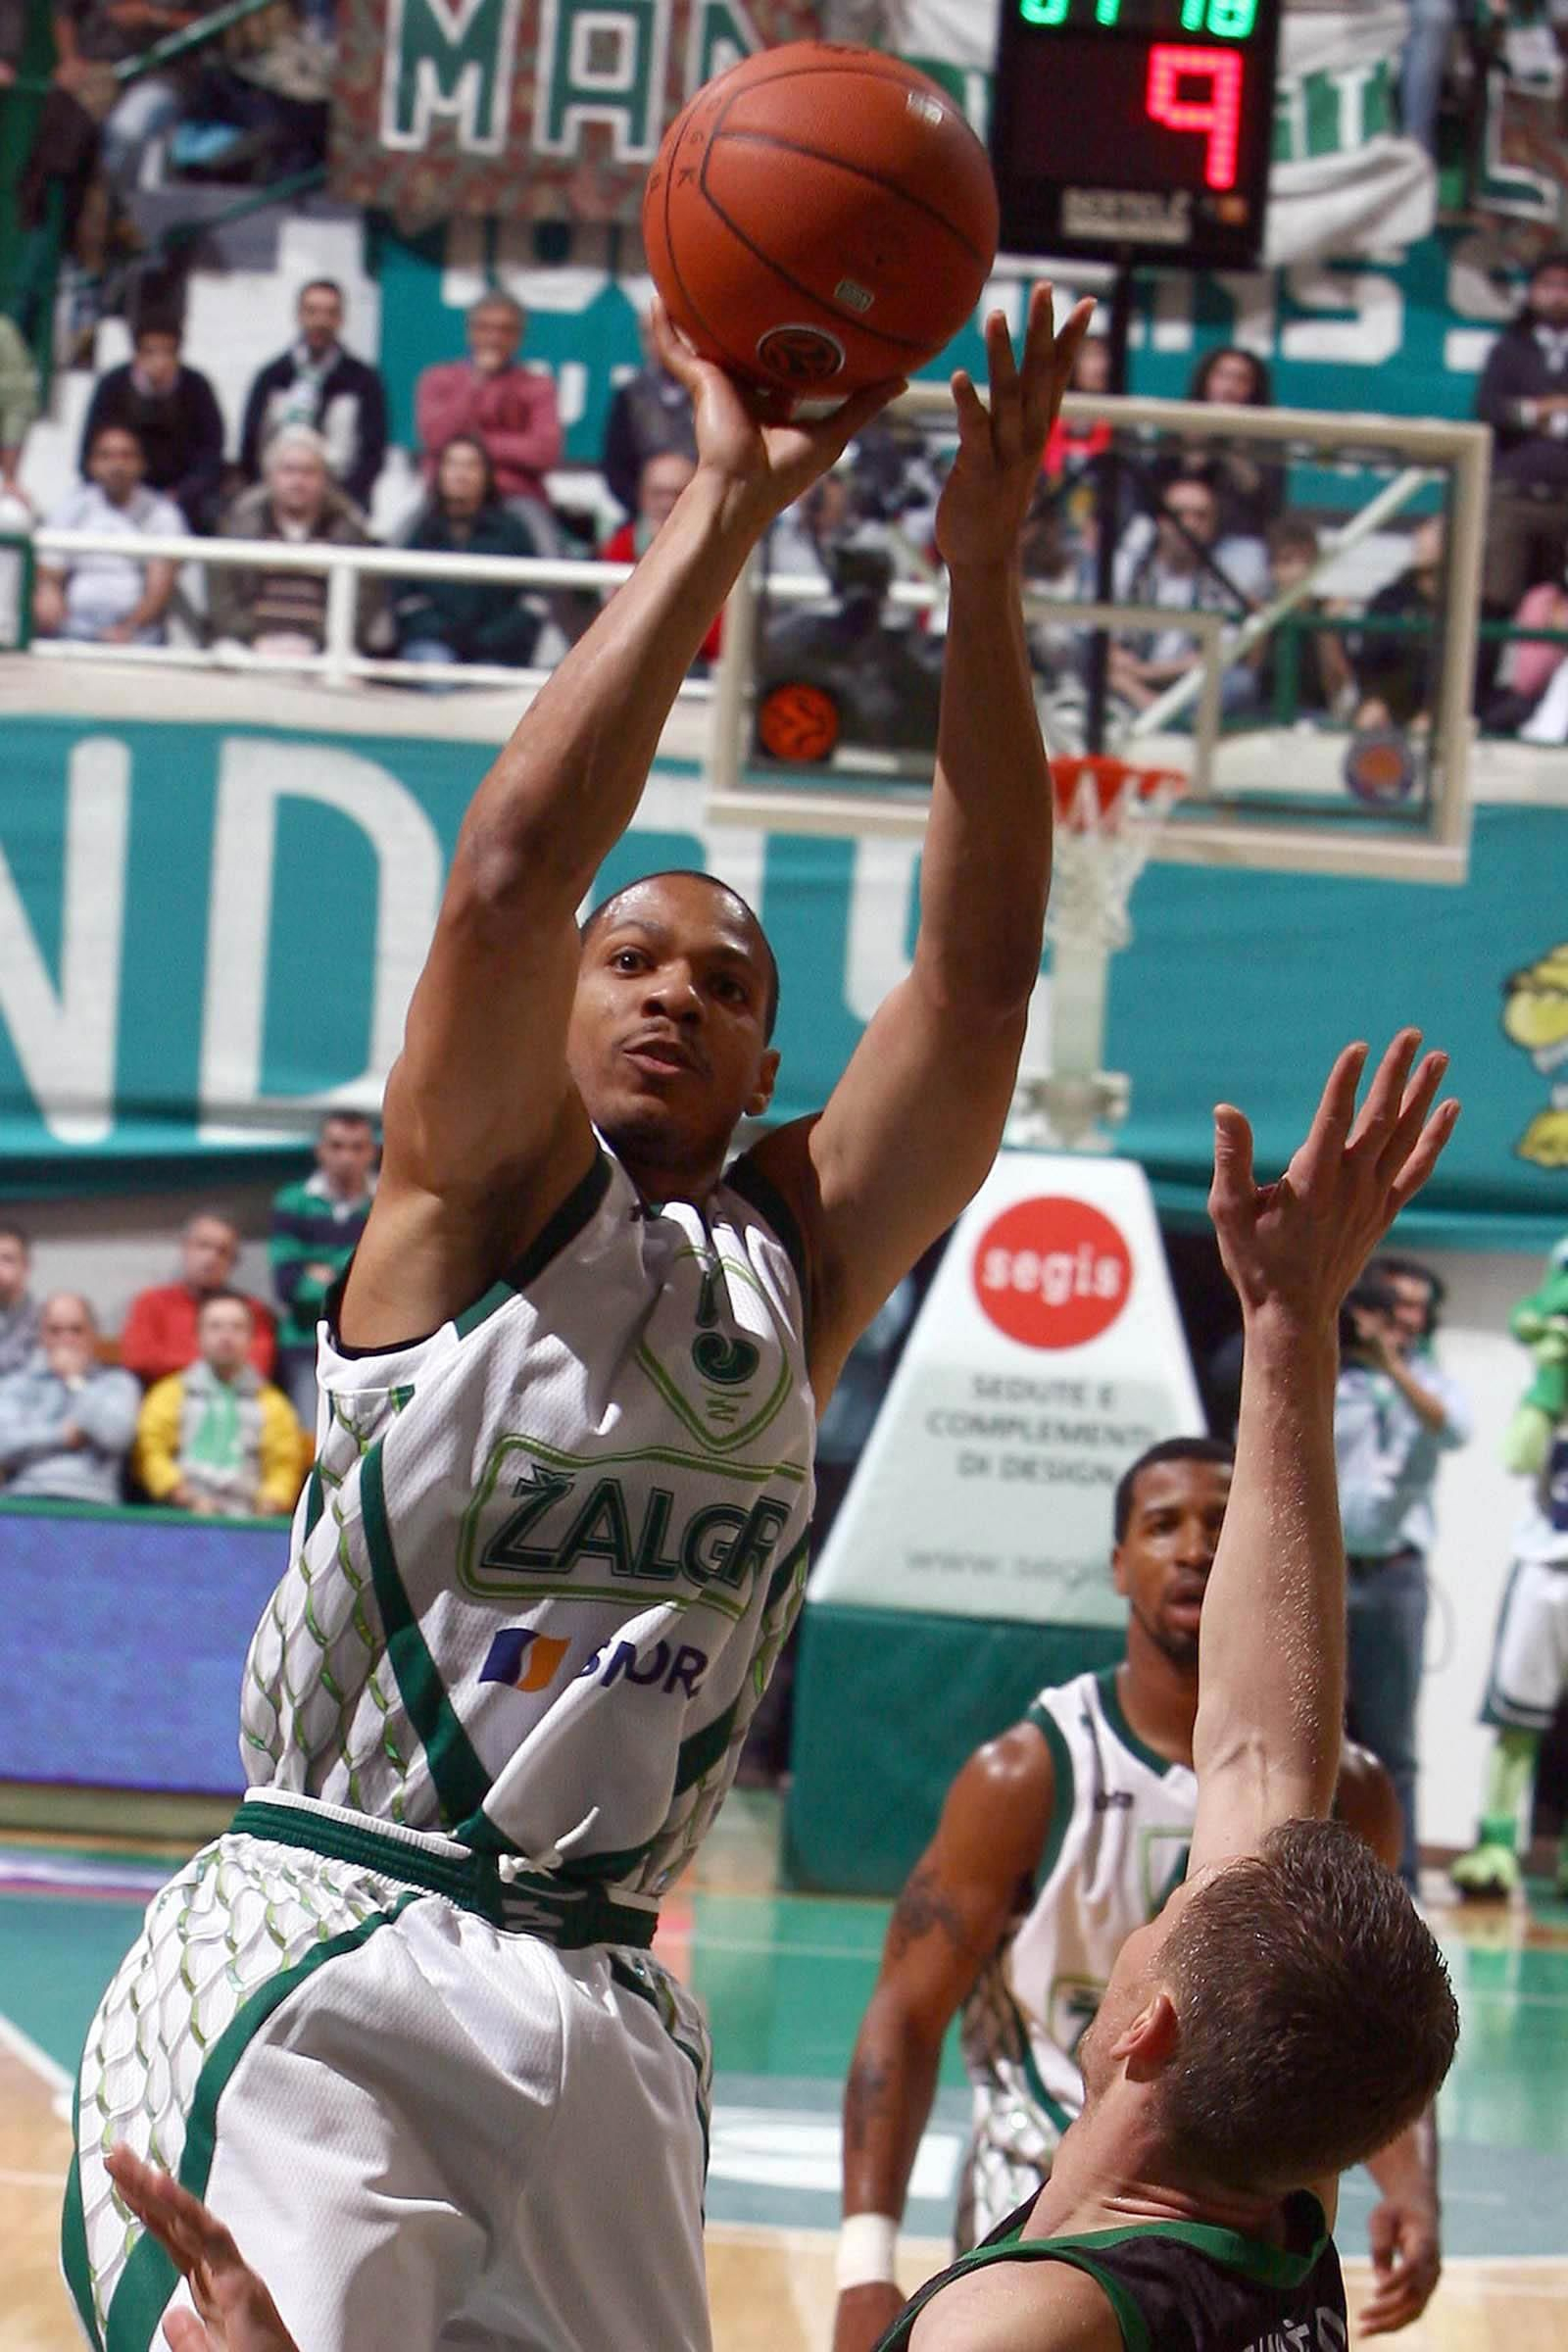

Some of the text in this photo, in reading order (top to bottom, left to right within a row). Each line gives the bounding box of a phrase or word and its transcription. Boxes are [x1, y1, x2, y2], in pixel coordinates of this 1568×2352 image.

[380, 0, 764, 161] MA
[1148, 43, 1243, 190] 9
[983, 1241, 1120, 1306] segis
